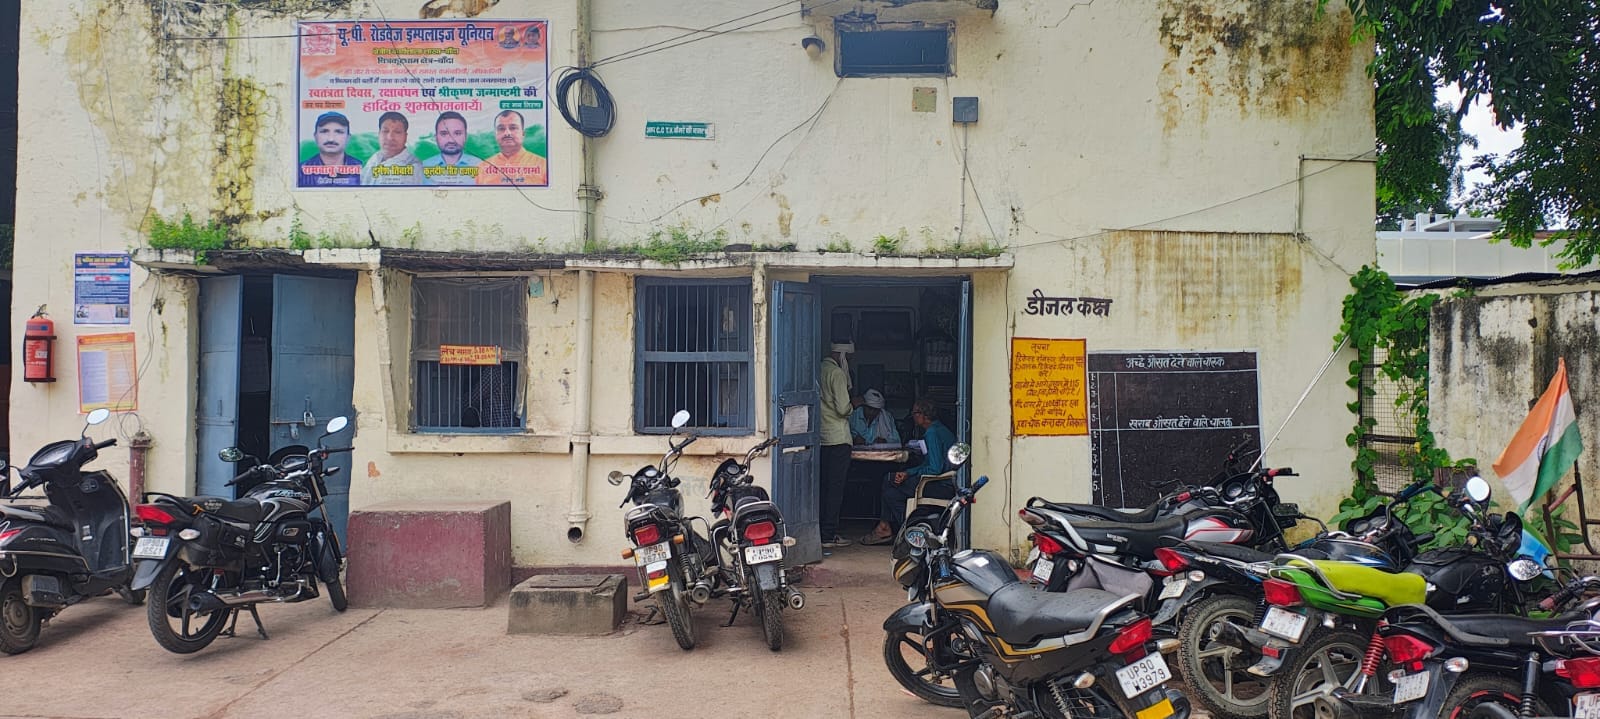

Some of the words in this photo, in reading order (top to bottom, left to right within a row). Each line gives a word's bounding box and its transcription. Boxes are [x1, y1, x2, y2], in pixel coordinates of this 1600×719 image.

[370, 24, 403, 41] रोडवेज
[457, 24, 494, 46] यूनियन
[308, 86, 344, 98] स्वतंत्रता
[421, 85, 437, 97] एवं
[438, 86, 473, 100] श्रीकृष्ण
[523, 85, 538, 97] की
[362, 98, 402, 113] हार्दिक
[1024, 288, 1077, 316] डीजल
[1077, 297, 1113, 317] कक्ष
[1031, 343, 1050, 354] सूचना
[1127, 659, 1155, 680] UP90
[1132, 668, 1166, 692] W3979
